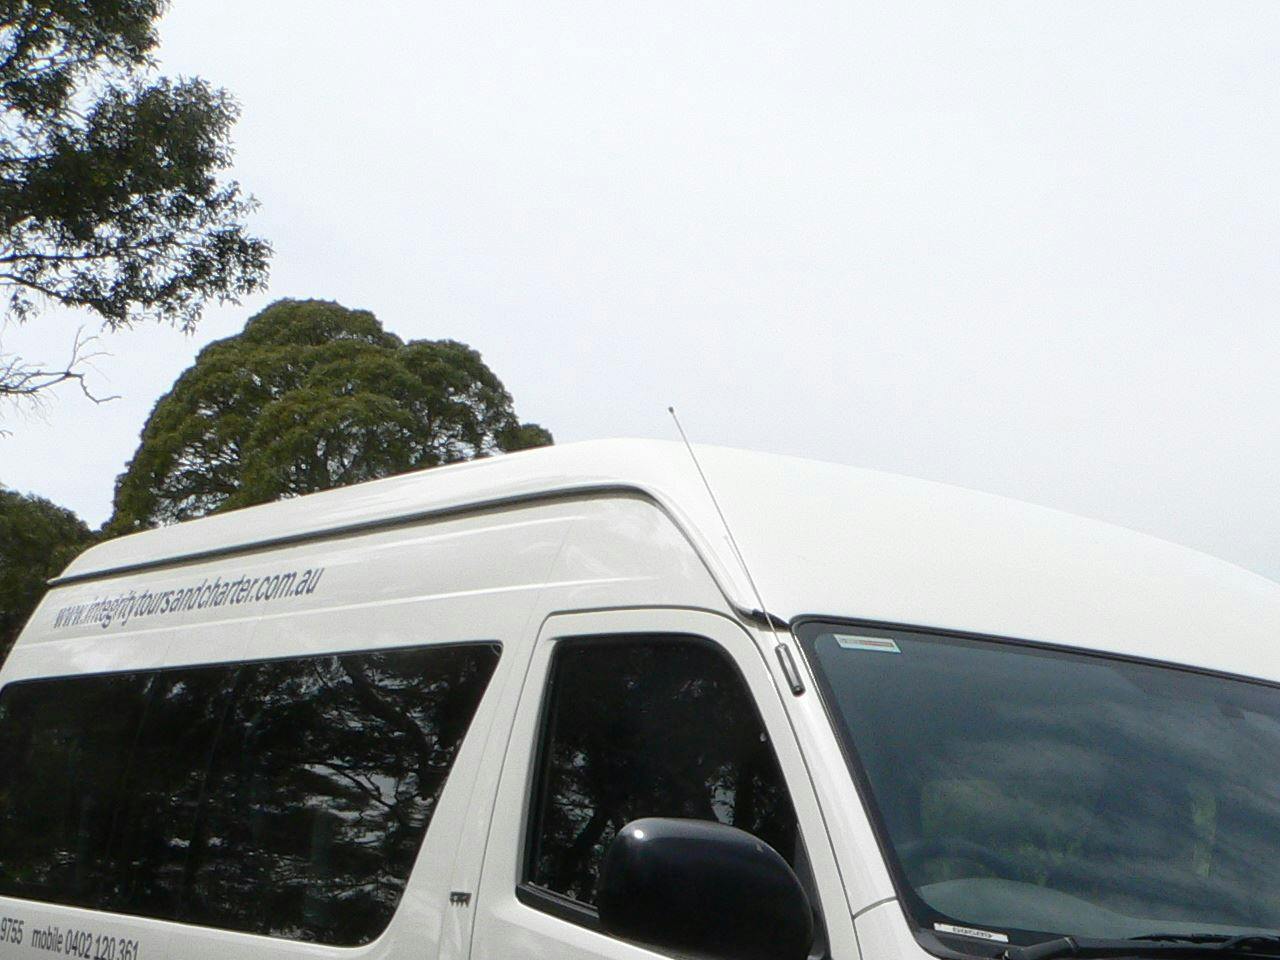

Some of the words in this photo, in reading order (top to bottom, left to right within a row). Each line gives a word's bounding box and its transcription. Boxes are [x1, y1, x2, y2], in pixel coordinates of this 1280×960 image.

[54, 568, 324, 629] www.integritytoursandcharter.com.au
[0, 917, 24, 945] 9755
[31, 926, 64, 953] mobile
[65, 929, 92, 959] 0402
